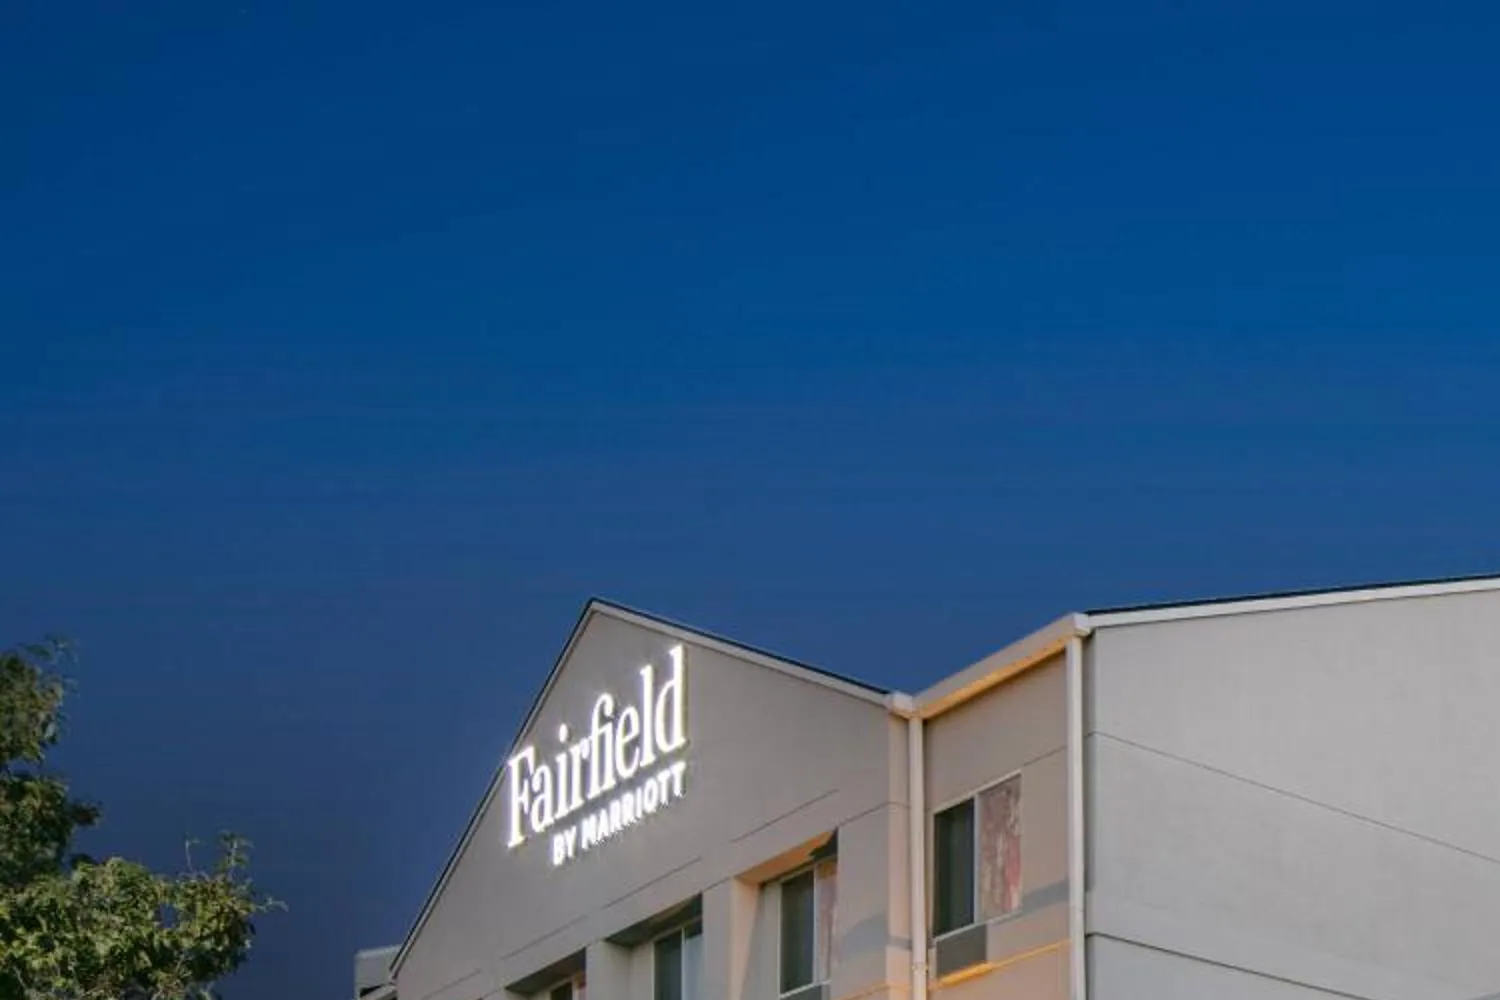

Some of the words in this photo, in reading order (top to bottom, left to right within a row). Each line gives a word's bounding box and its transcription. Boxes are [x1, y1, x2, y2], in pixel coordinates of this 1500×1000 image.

[507, 644, 687, 849] Fairfield
[553, 827, 577, 867] BY
[582, 760, 687, 850] MARRIOTT
